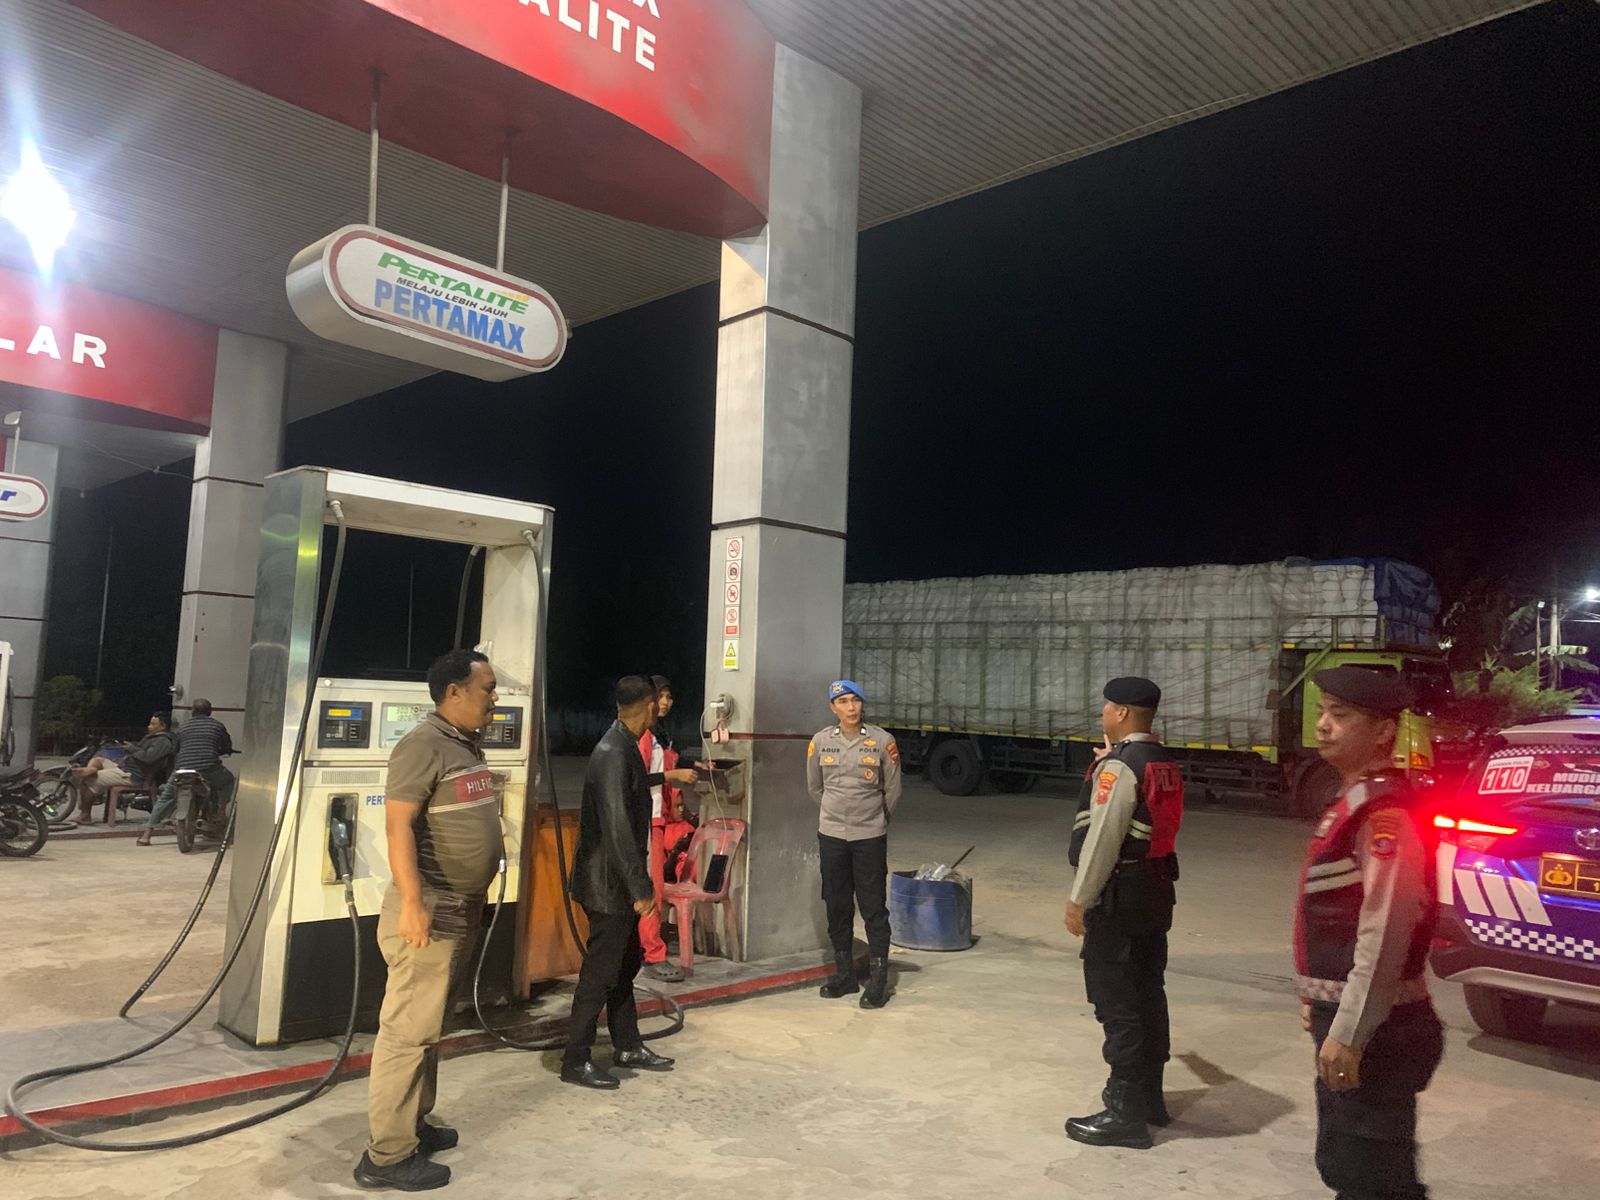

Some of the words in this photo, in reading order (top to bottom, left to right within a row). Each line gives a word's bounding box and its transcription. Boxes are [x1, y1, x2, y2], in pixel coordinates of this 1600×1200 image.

[377, 252, 529, 315] PERTALITE
[396, 277, 444, 298] MELAJU
[445, 293, 478, 309] LEBIH
[479, 304, 508, 319] JAUH
[374, 278, 526, 354] PERTAMAX
[1486, 768, 1526, 789] 110
